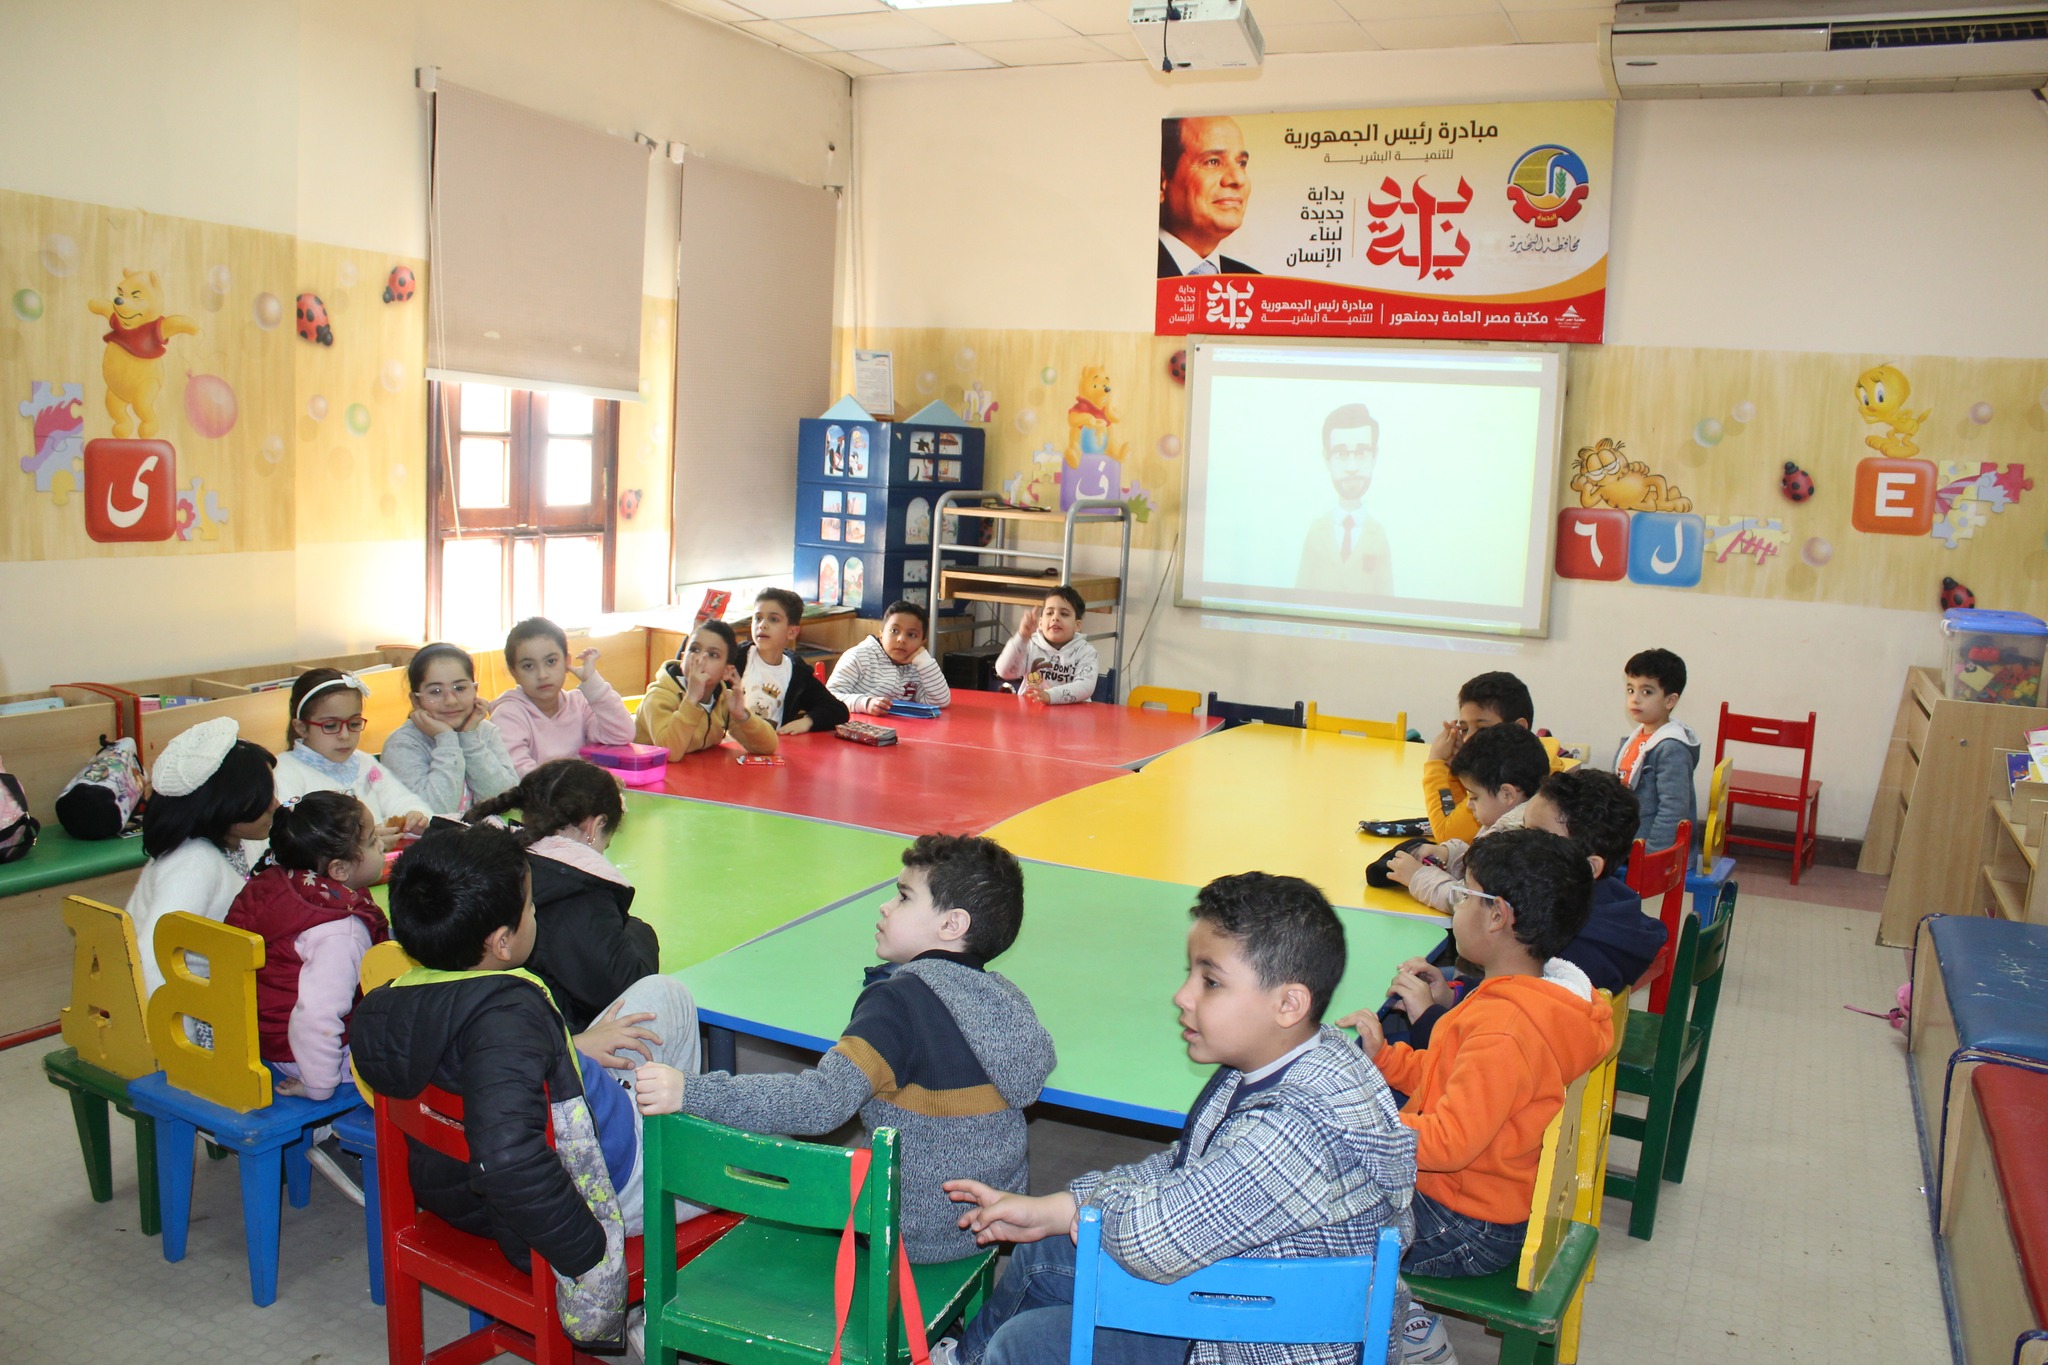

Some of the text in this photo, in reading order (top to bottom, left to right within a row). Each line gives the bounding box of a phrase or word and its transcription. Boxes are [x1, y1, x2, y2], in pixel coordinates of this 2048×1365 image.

[1284, 120, 1498, 149] مبادرة رئيس الجمهورية
[1307, 185, 1345, 205] بداية
[1300, 206, 1344, 224] جديدة
[1309, 226, 1342, 245] لبناء
[1286, 247, 1342, 268] الإنسان
[1175, 294, 1196, 303] جديدة
[1178, 285, 1196, 295] بداية
[1179, 303, 1195, 313] لبناء
[1261, 299, 1373, 313] مبادرة رئيس الجمهورية
[1169, 313, 1195, 324] الإنسان
[1389, 310, 1548, 327] مكتبة مصر العامة بدمنهور
[1875, 472, 1916, 518] E
[1574, 520, 1603, 568] ٦
[1651, 520, 1683, 575] ل
[1053, 663, 1076, 675] DON'T
